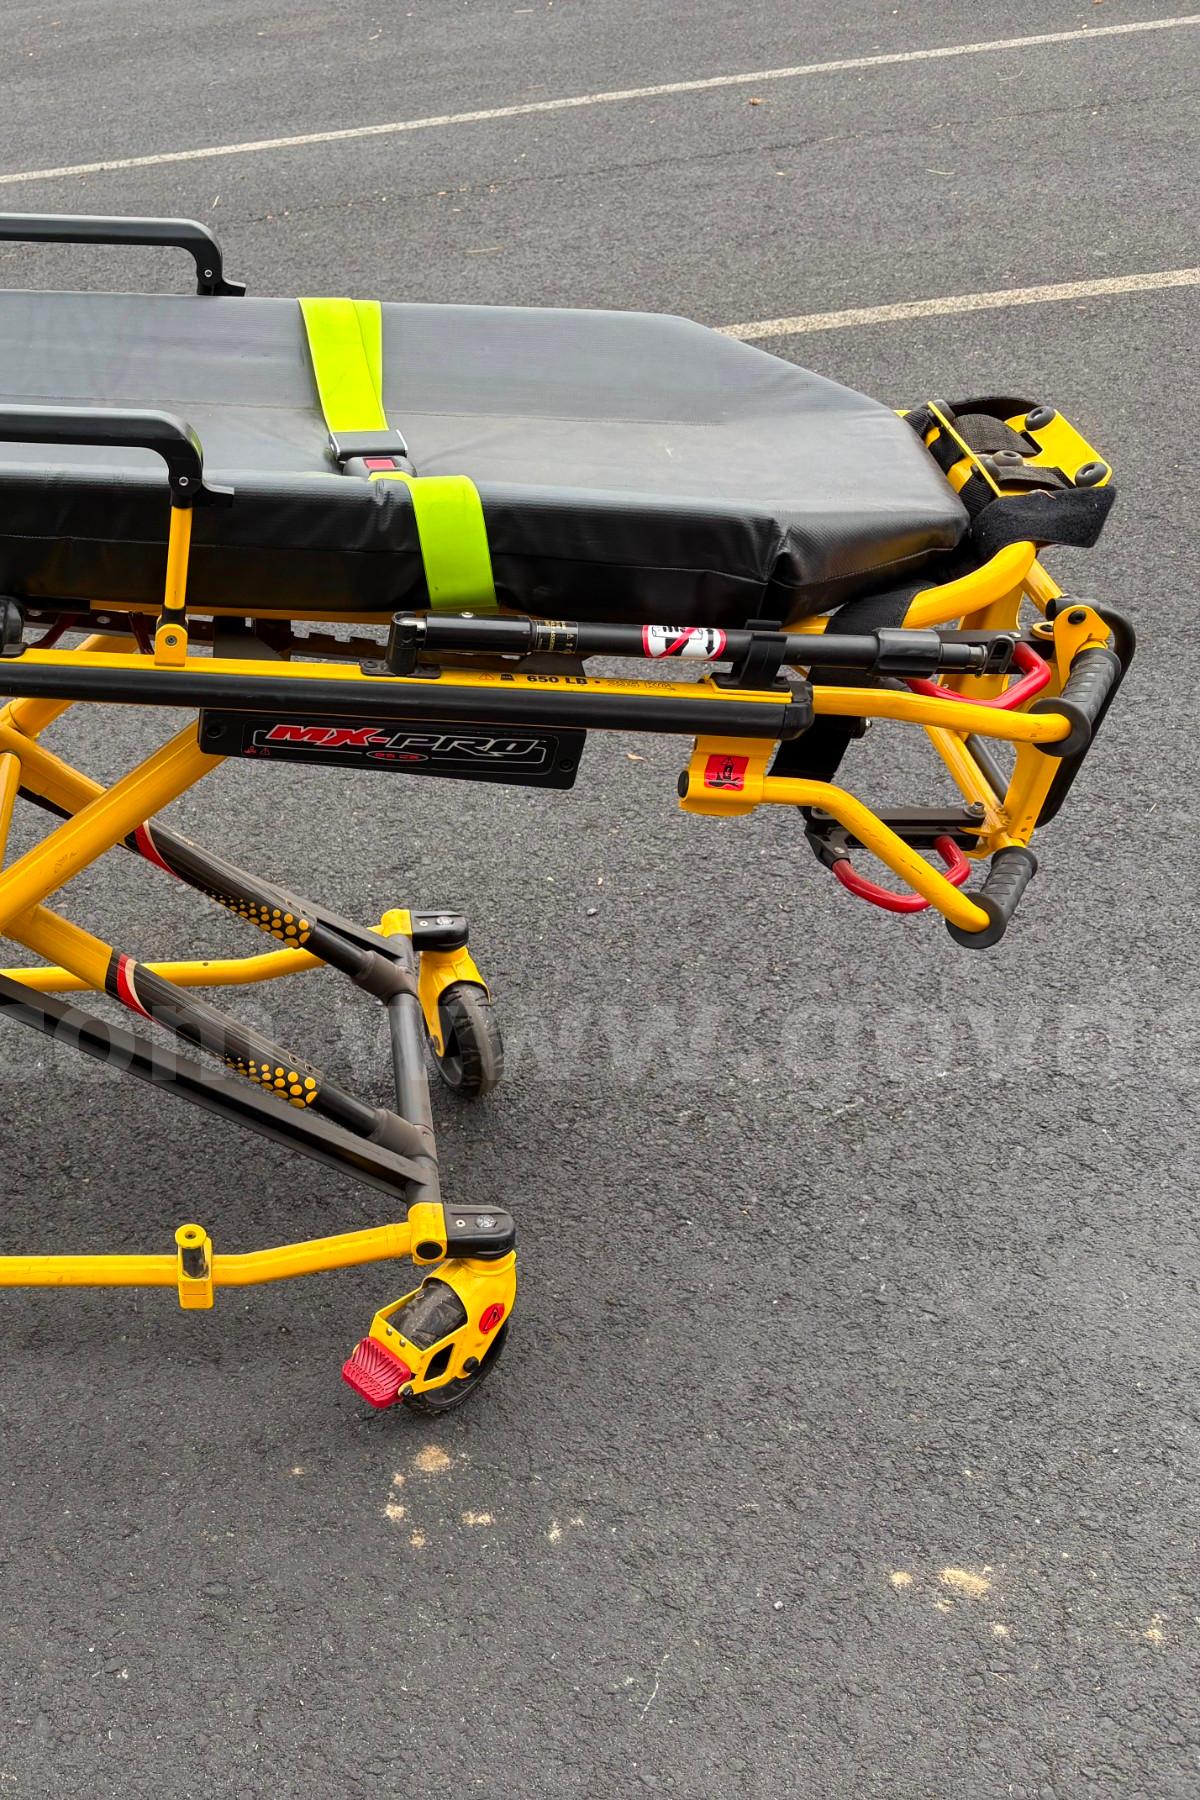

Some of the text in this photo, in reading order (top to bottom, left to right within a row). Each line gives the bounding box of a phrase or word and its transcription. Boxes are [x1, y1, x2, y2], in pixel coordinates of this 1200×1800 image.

[526, 675, 560, 684] 650
[566, 676, 589, 685] LB
[265, 724, 540, 757] MX-PRO
